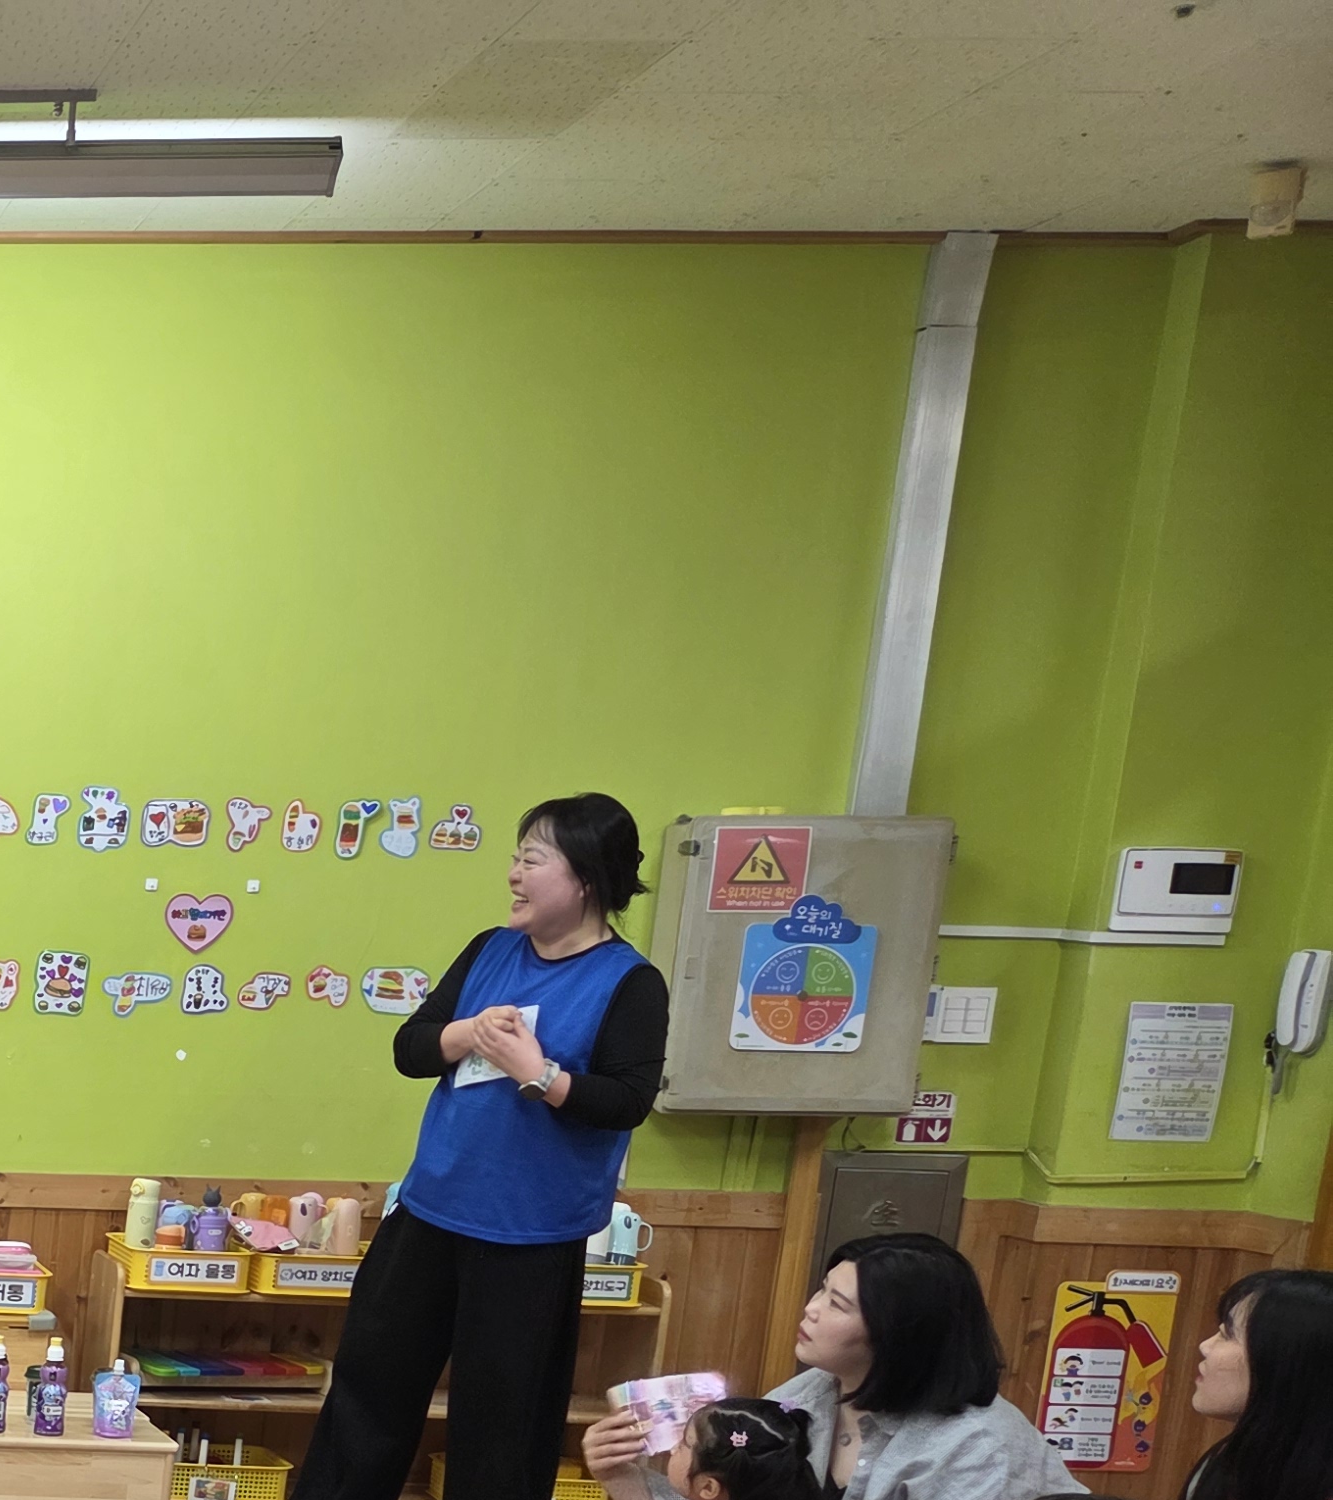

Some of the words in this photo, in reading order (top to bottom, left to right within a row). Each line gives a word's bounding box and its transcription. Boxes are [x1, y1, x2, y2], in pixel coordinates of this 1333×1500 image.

[795, 905, 832, 923] 오늘의
[801, 922, 844, 939] 대기질
[168, 1261, 200, 1279] 여자
[205, 1263, 236, 1279] 물통
[294, 1270, 318, 1281] 여자
[321, 1270, 355, 1283] 양치도
